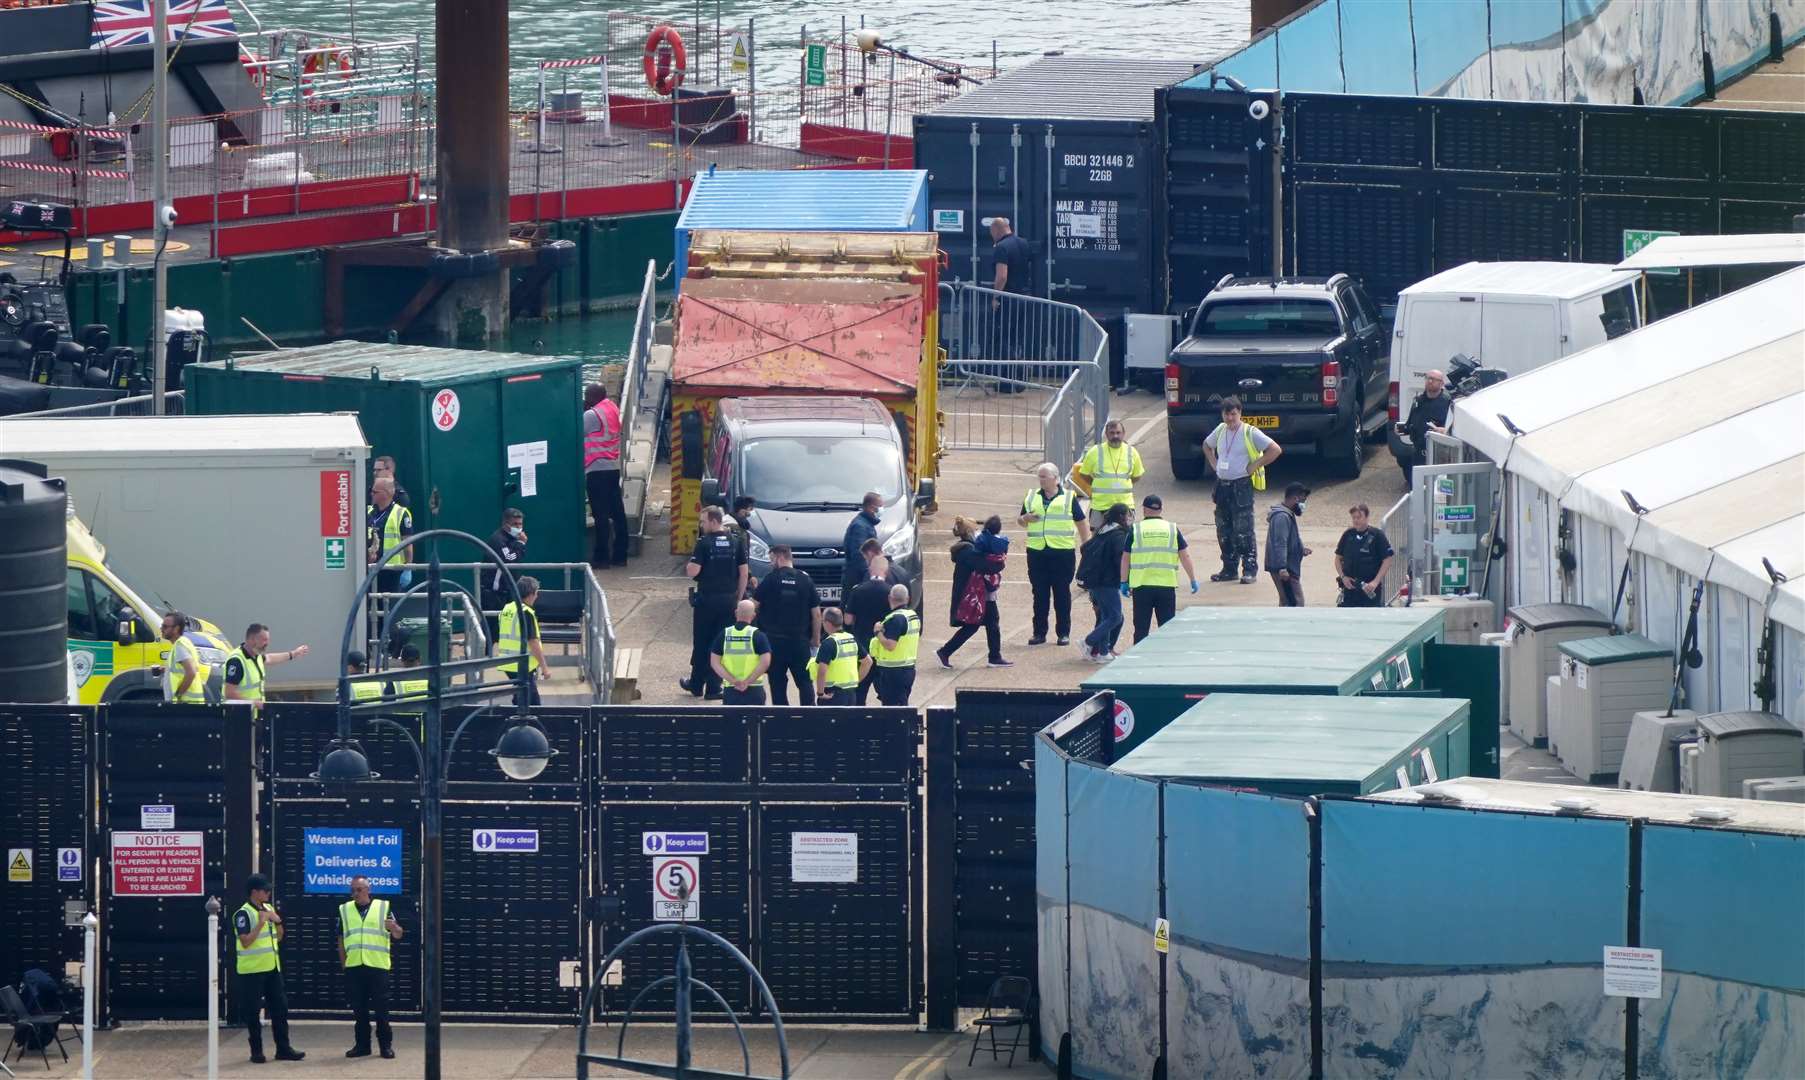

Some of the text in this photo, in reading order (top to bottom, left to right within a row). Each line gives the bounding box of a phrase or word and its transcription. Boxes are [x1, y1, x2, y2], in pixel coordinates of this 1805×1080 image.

[1064, 154, 1134, 167] BBCU 321446 2
[1056, 225, 1071, 237] NET
[337, 473, 349, 534] Portakabin
[135, 835, 181, 846] NOTICE
[308, 834, 398, 845] Western Jet Foil
[496, 836, 535, 845] Keep clear
[667, 838, 685, 847] Keep
[315, 855, 392, 868] Deliveries &
[308, 874, 399, 886] Vehicle ccess
[668, 866, 686, 887] 5
